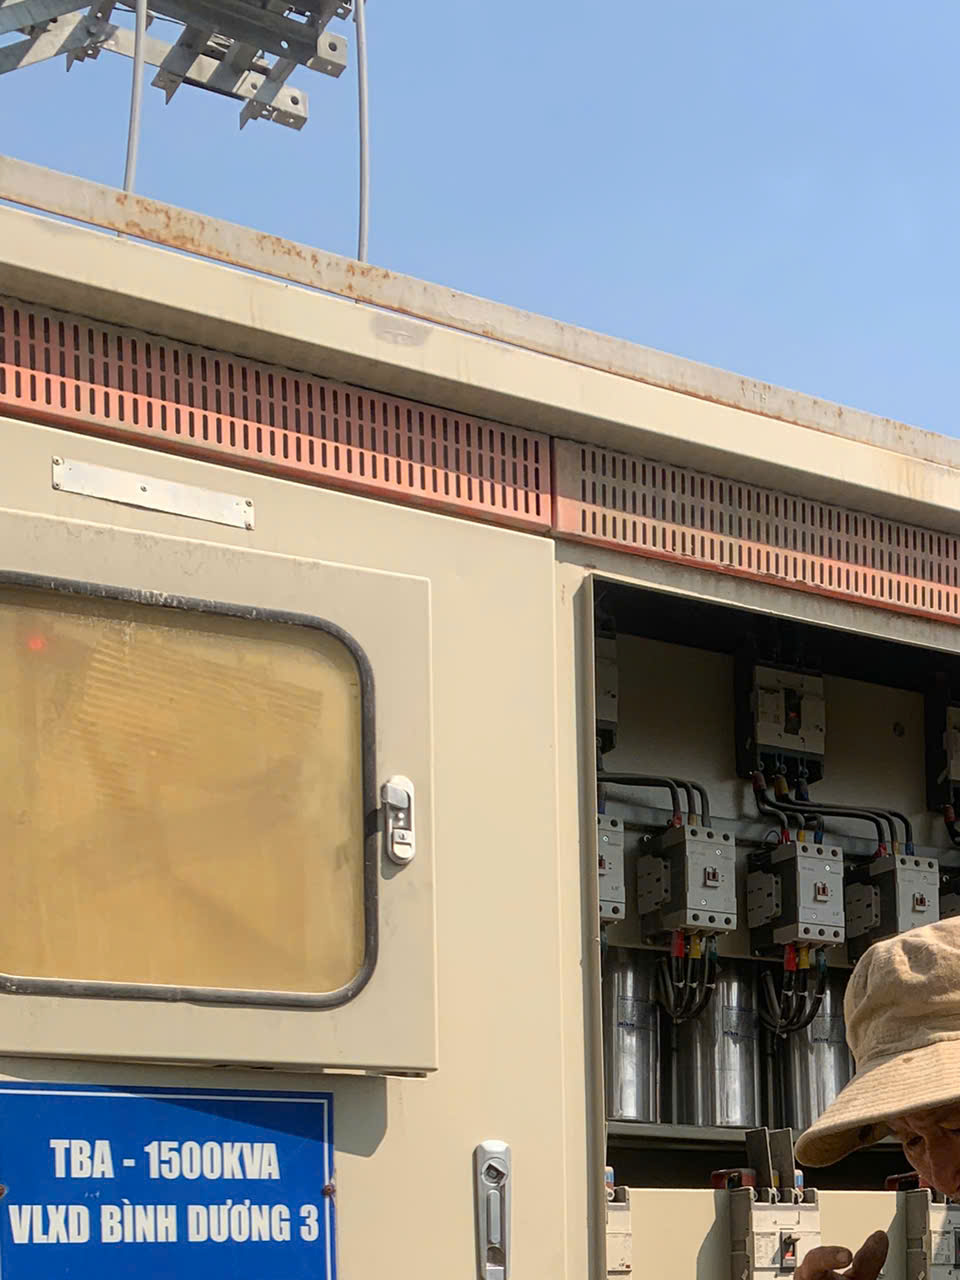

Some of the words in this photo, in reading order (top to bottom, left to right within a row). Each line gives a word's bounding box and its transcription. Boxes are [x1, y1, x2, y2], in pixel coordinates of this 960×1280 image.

[49, 1139, 115, 1179] TBA
[143, 1140, 281, 1180] 1500KVA
[7, 1204, 90, 1244] VLXD
[100, 1198, 178, 1243] BÌNH
[187, 1199, 291, 1242] DƯƠNG
[299, 1204, 319, 1242] 3
